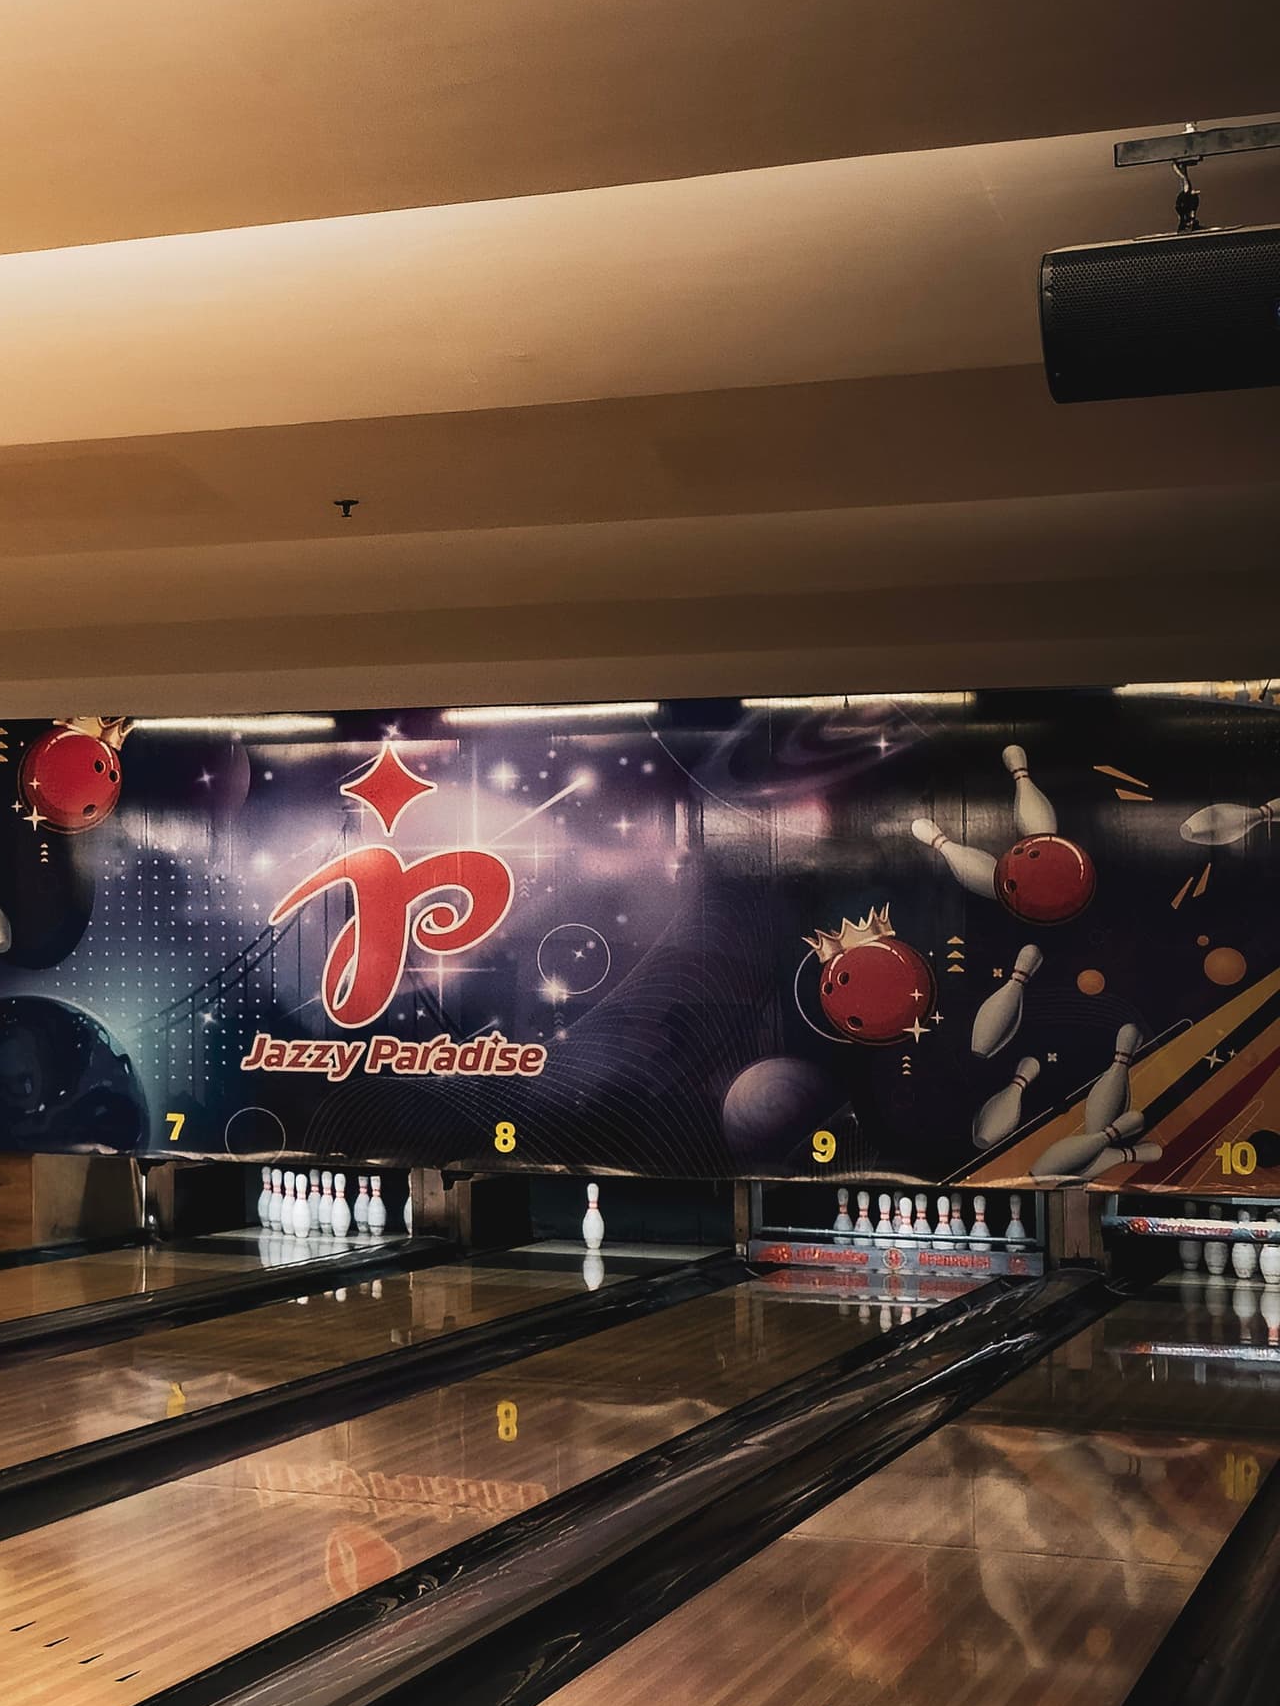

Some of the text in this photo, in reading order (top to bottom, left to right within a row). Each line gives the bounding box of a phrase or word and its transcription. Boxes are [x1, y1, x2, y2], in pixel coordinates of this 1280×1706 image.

[240, 1030, 548, 1082] Jazzy Paradise
[165, 1112, 186, 1142] 7
[493, 1120, 517, 1153] 8
[811, 1129, 837, 1164] 9
[1214, 1140, 1258, 1176] 10
